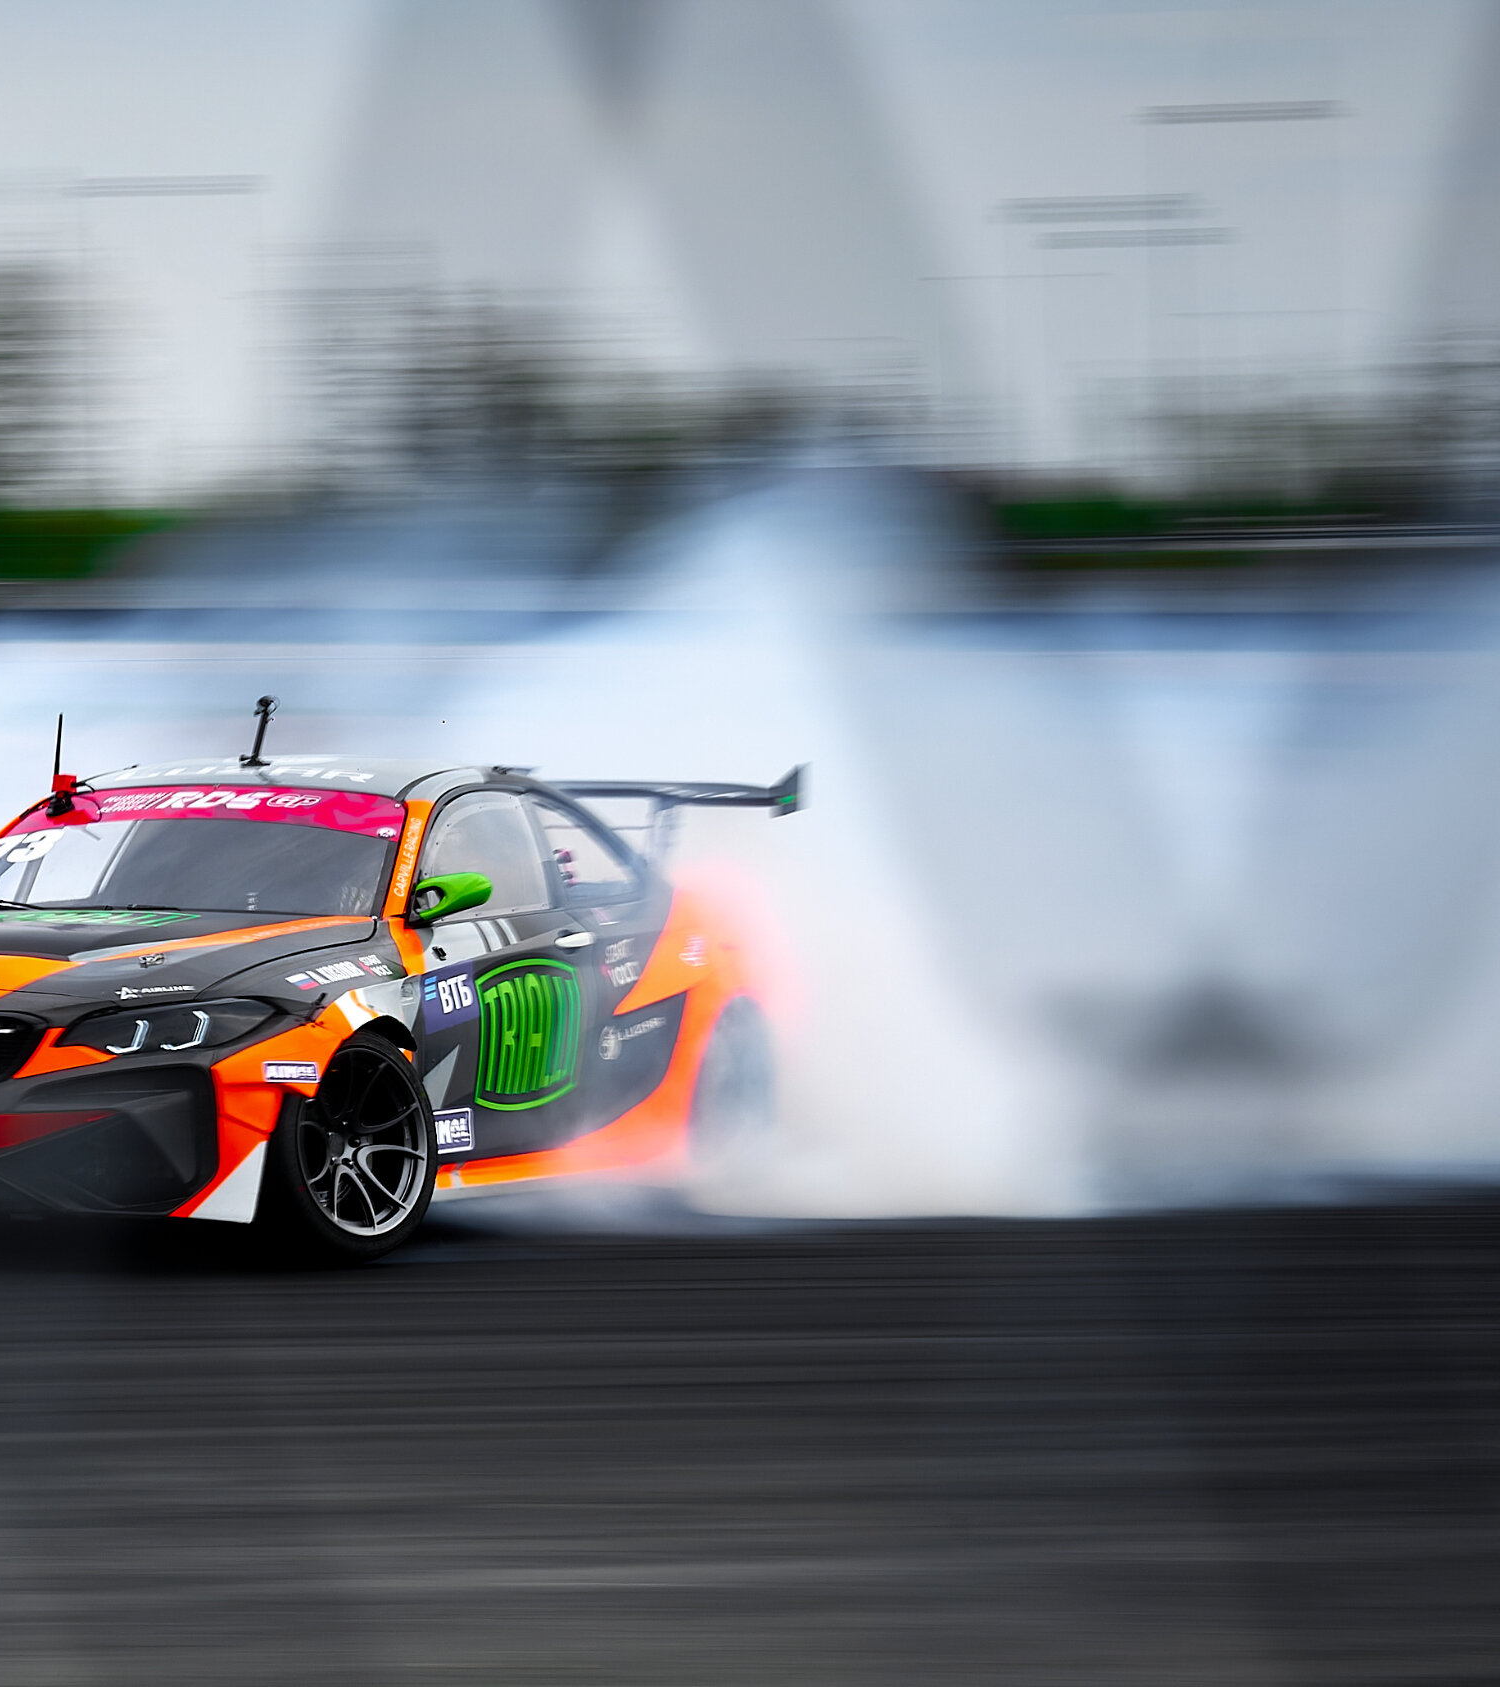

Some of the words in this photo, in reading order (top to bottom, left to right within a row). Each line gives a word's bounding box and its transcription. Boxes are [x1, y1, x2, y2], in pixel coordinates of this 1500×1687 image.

[156, 790, 278, 809] RDS
[141, 985, 197, 994] AIRLINE
[437, 973, 474, 1014] ВТБ
